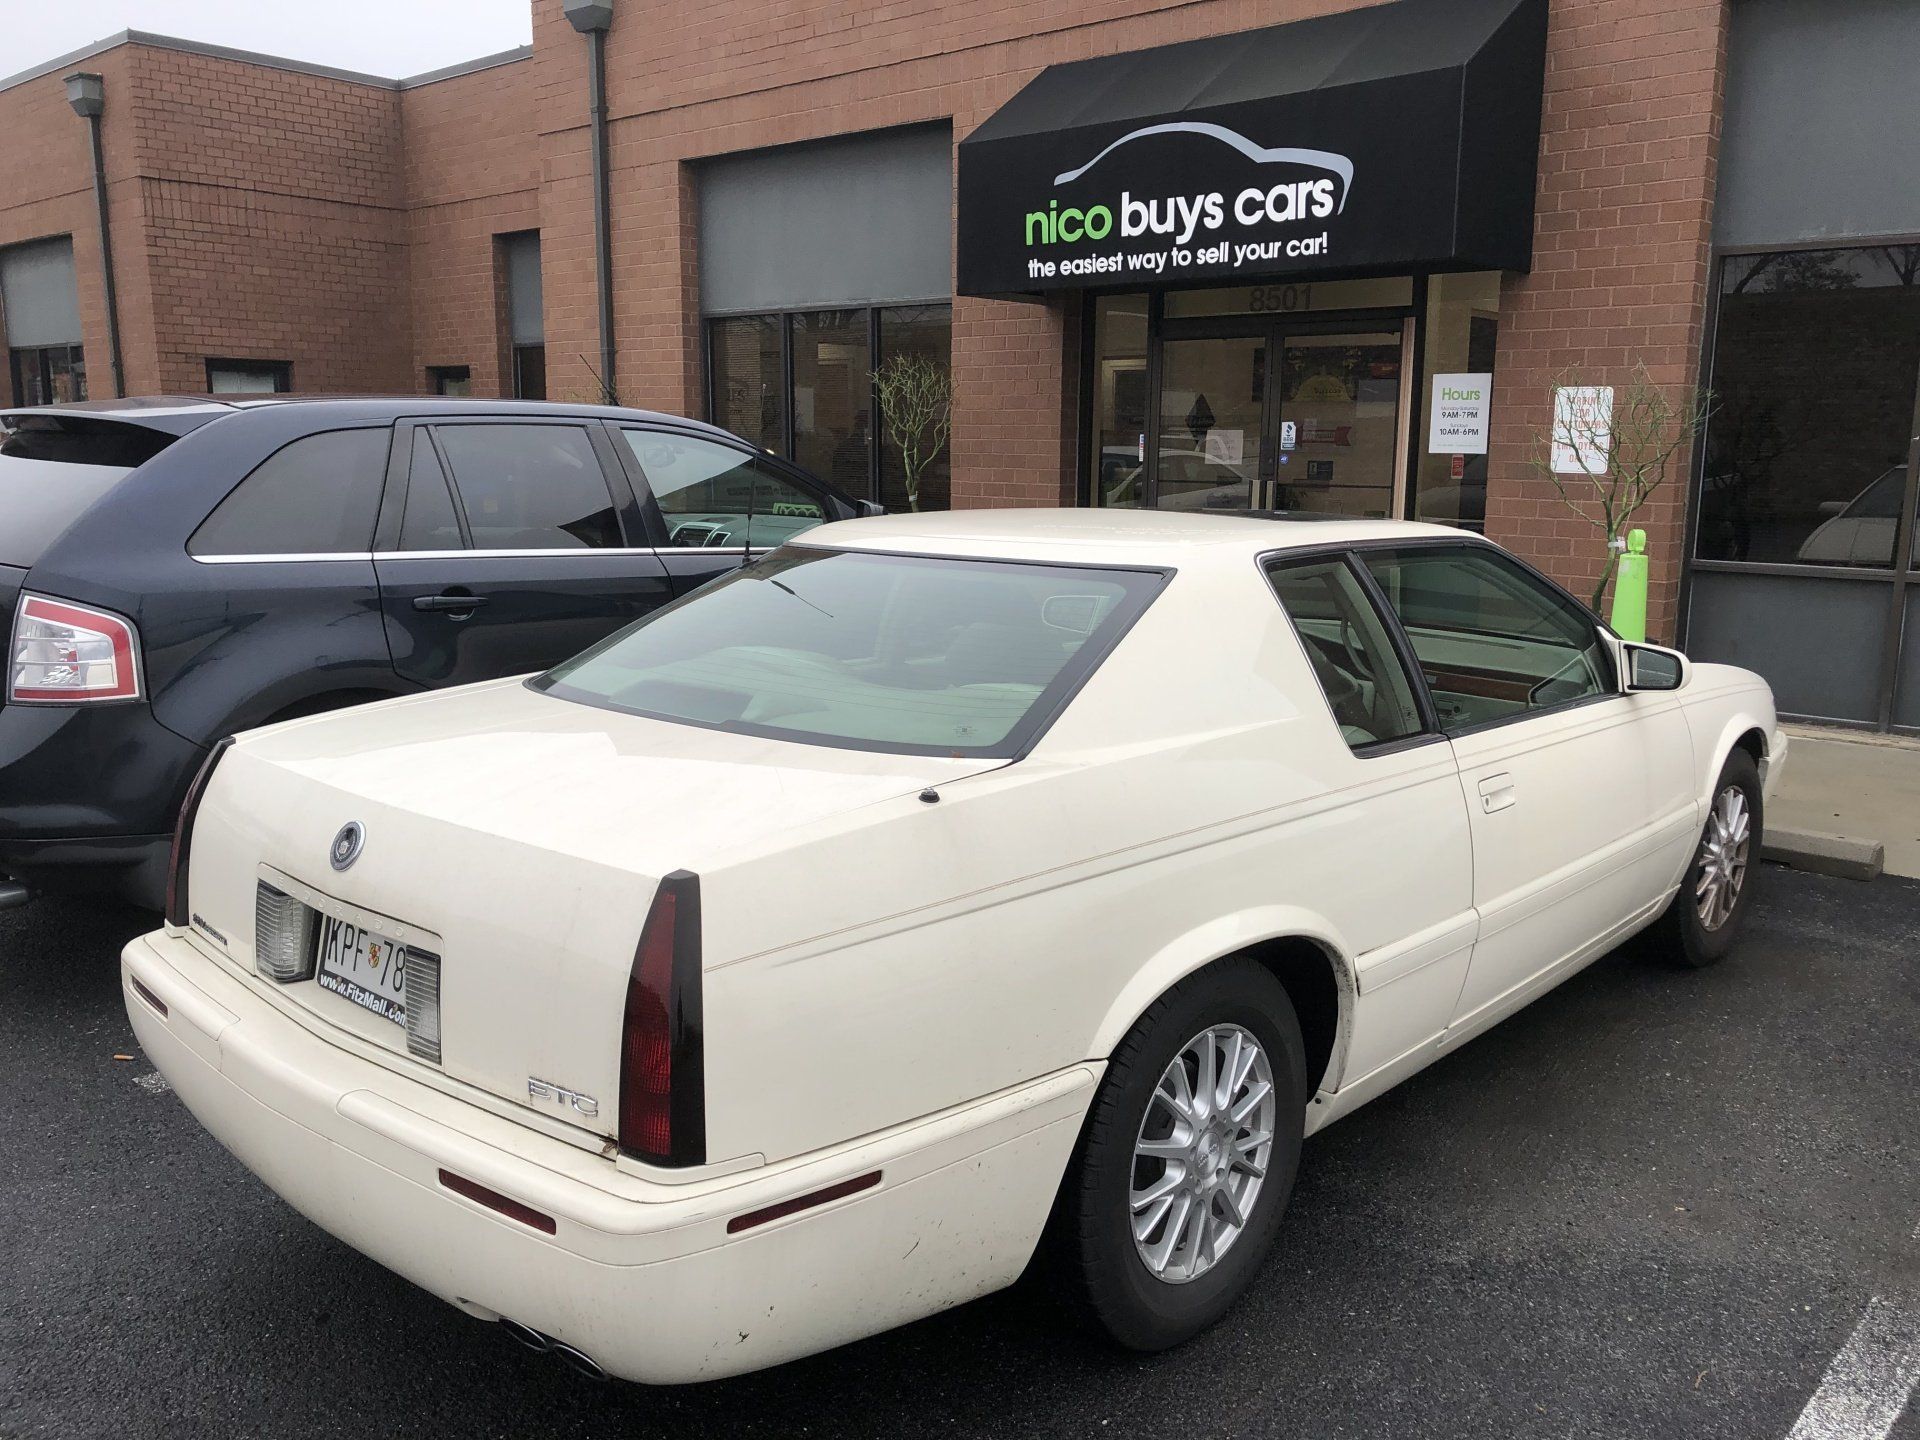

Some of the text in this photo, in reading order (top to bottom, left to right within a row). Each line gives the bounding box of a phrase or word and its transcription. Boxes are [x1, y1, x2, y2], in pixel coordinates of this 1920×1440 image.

[1026, 178, 1335, 246] nico buys cars
[1028, 231, 1328, 278] the easiest way to sell your car!
[1249, 286, 1312, 311] 8501
[1441, 387, 1481, 401] Hours
[277, 876, 405, 938] ELDORADO
[328, 915, 369, 972] KPF
[528, 1077, 599, 1117] ETC
